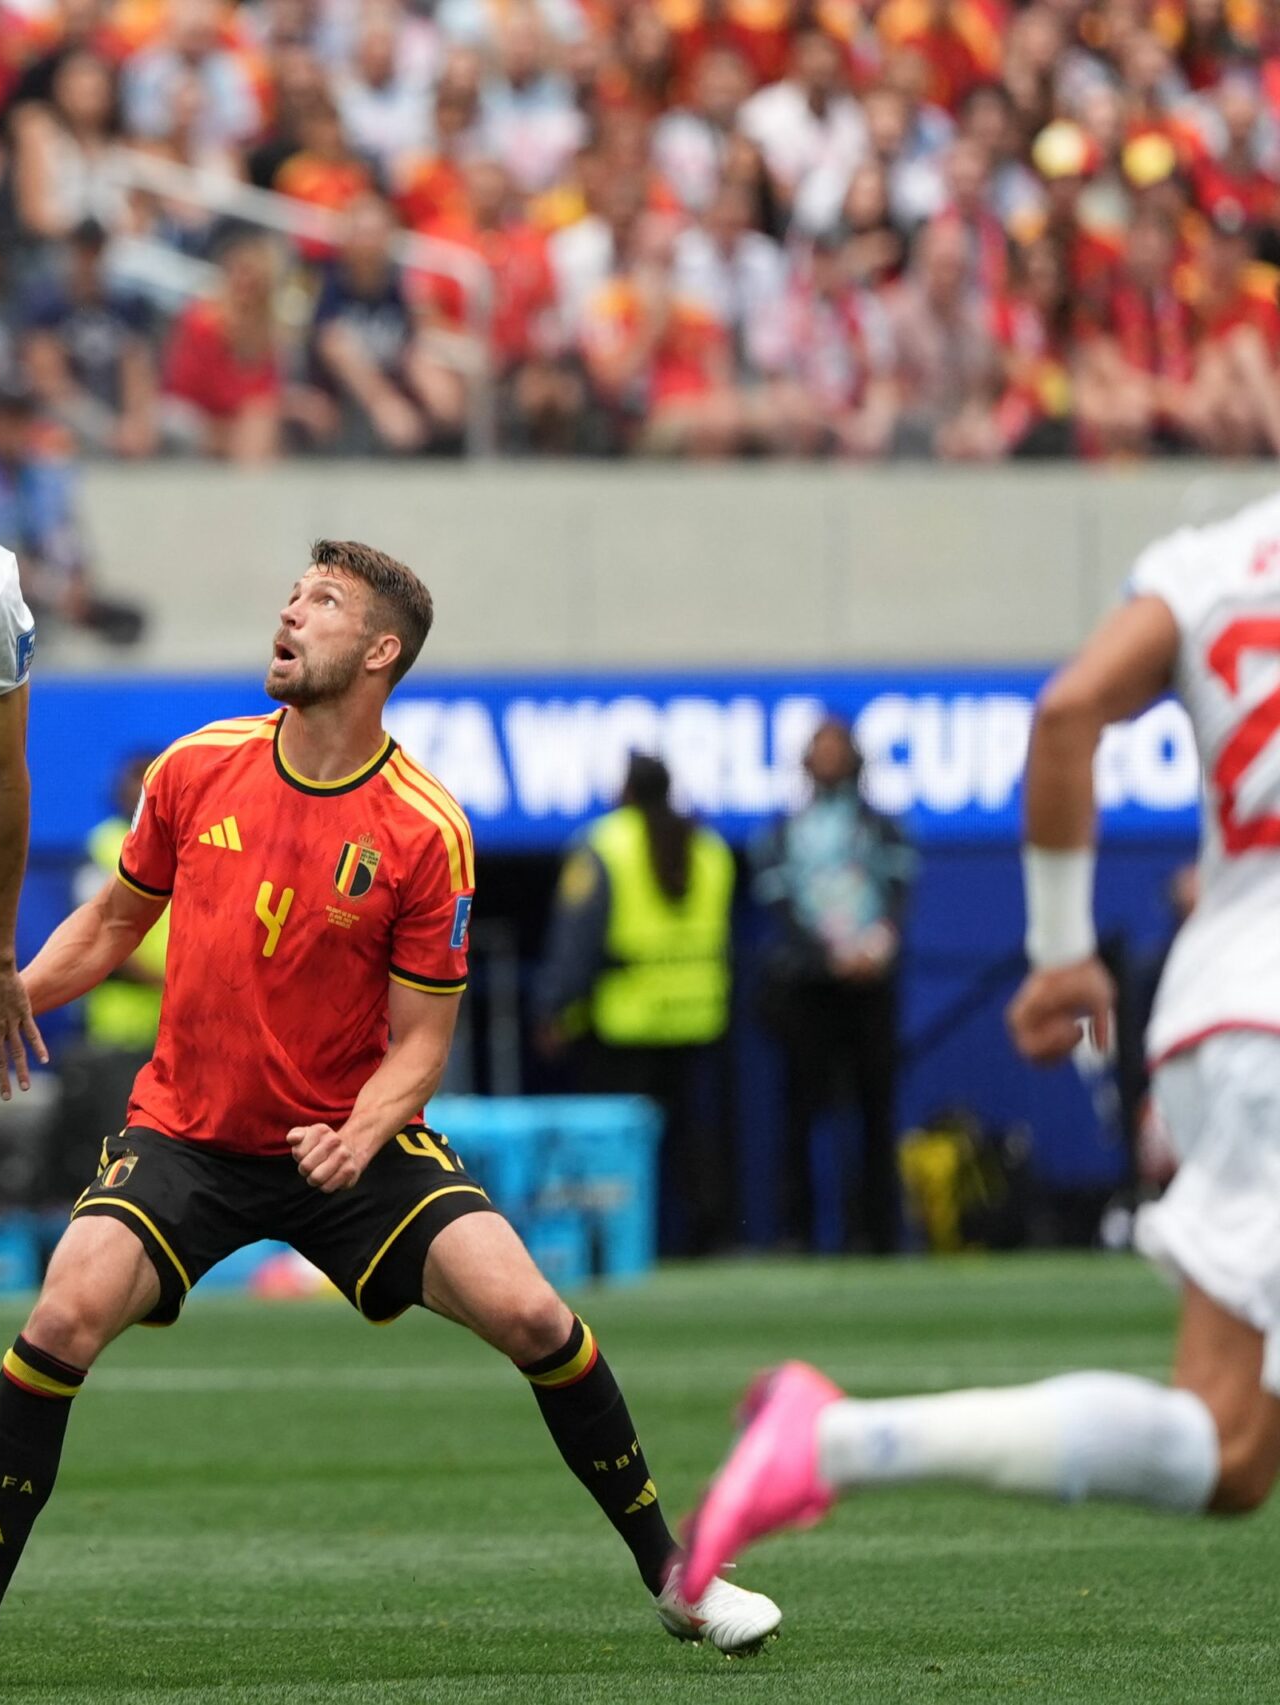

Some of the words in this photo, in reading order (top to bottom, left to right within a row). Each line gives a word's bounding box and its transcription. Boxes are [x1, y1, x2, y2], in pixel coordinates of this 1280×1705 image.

[502, 695, 830, 817] WORLD
[851, 693, 1034, 816] CUP
[254, 881, 295, 957] 4
[395, 1131, 456, 1172] 4
